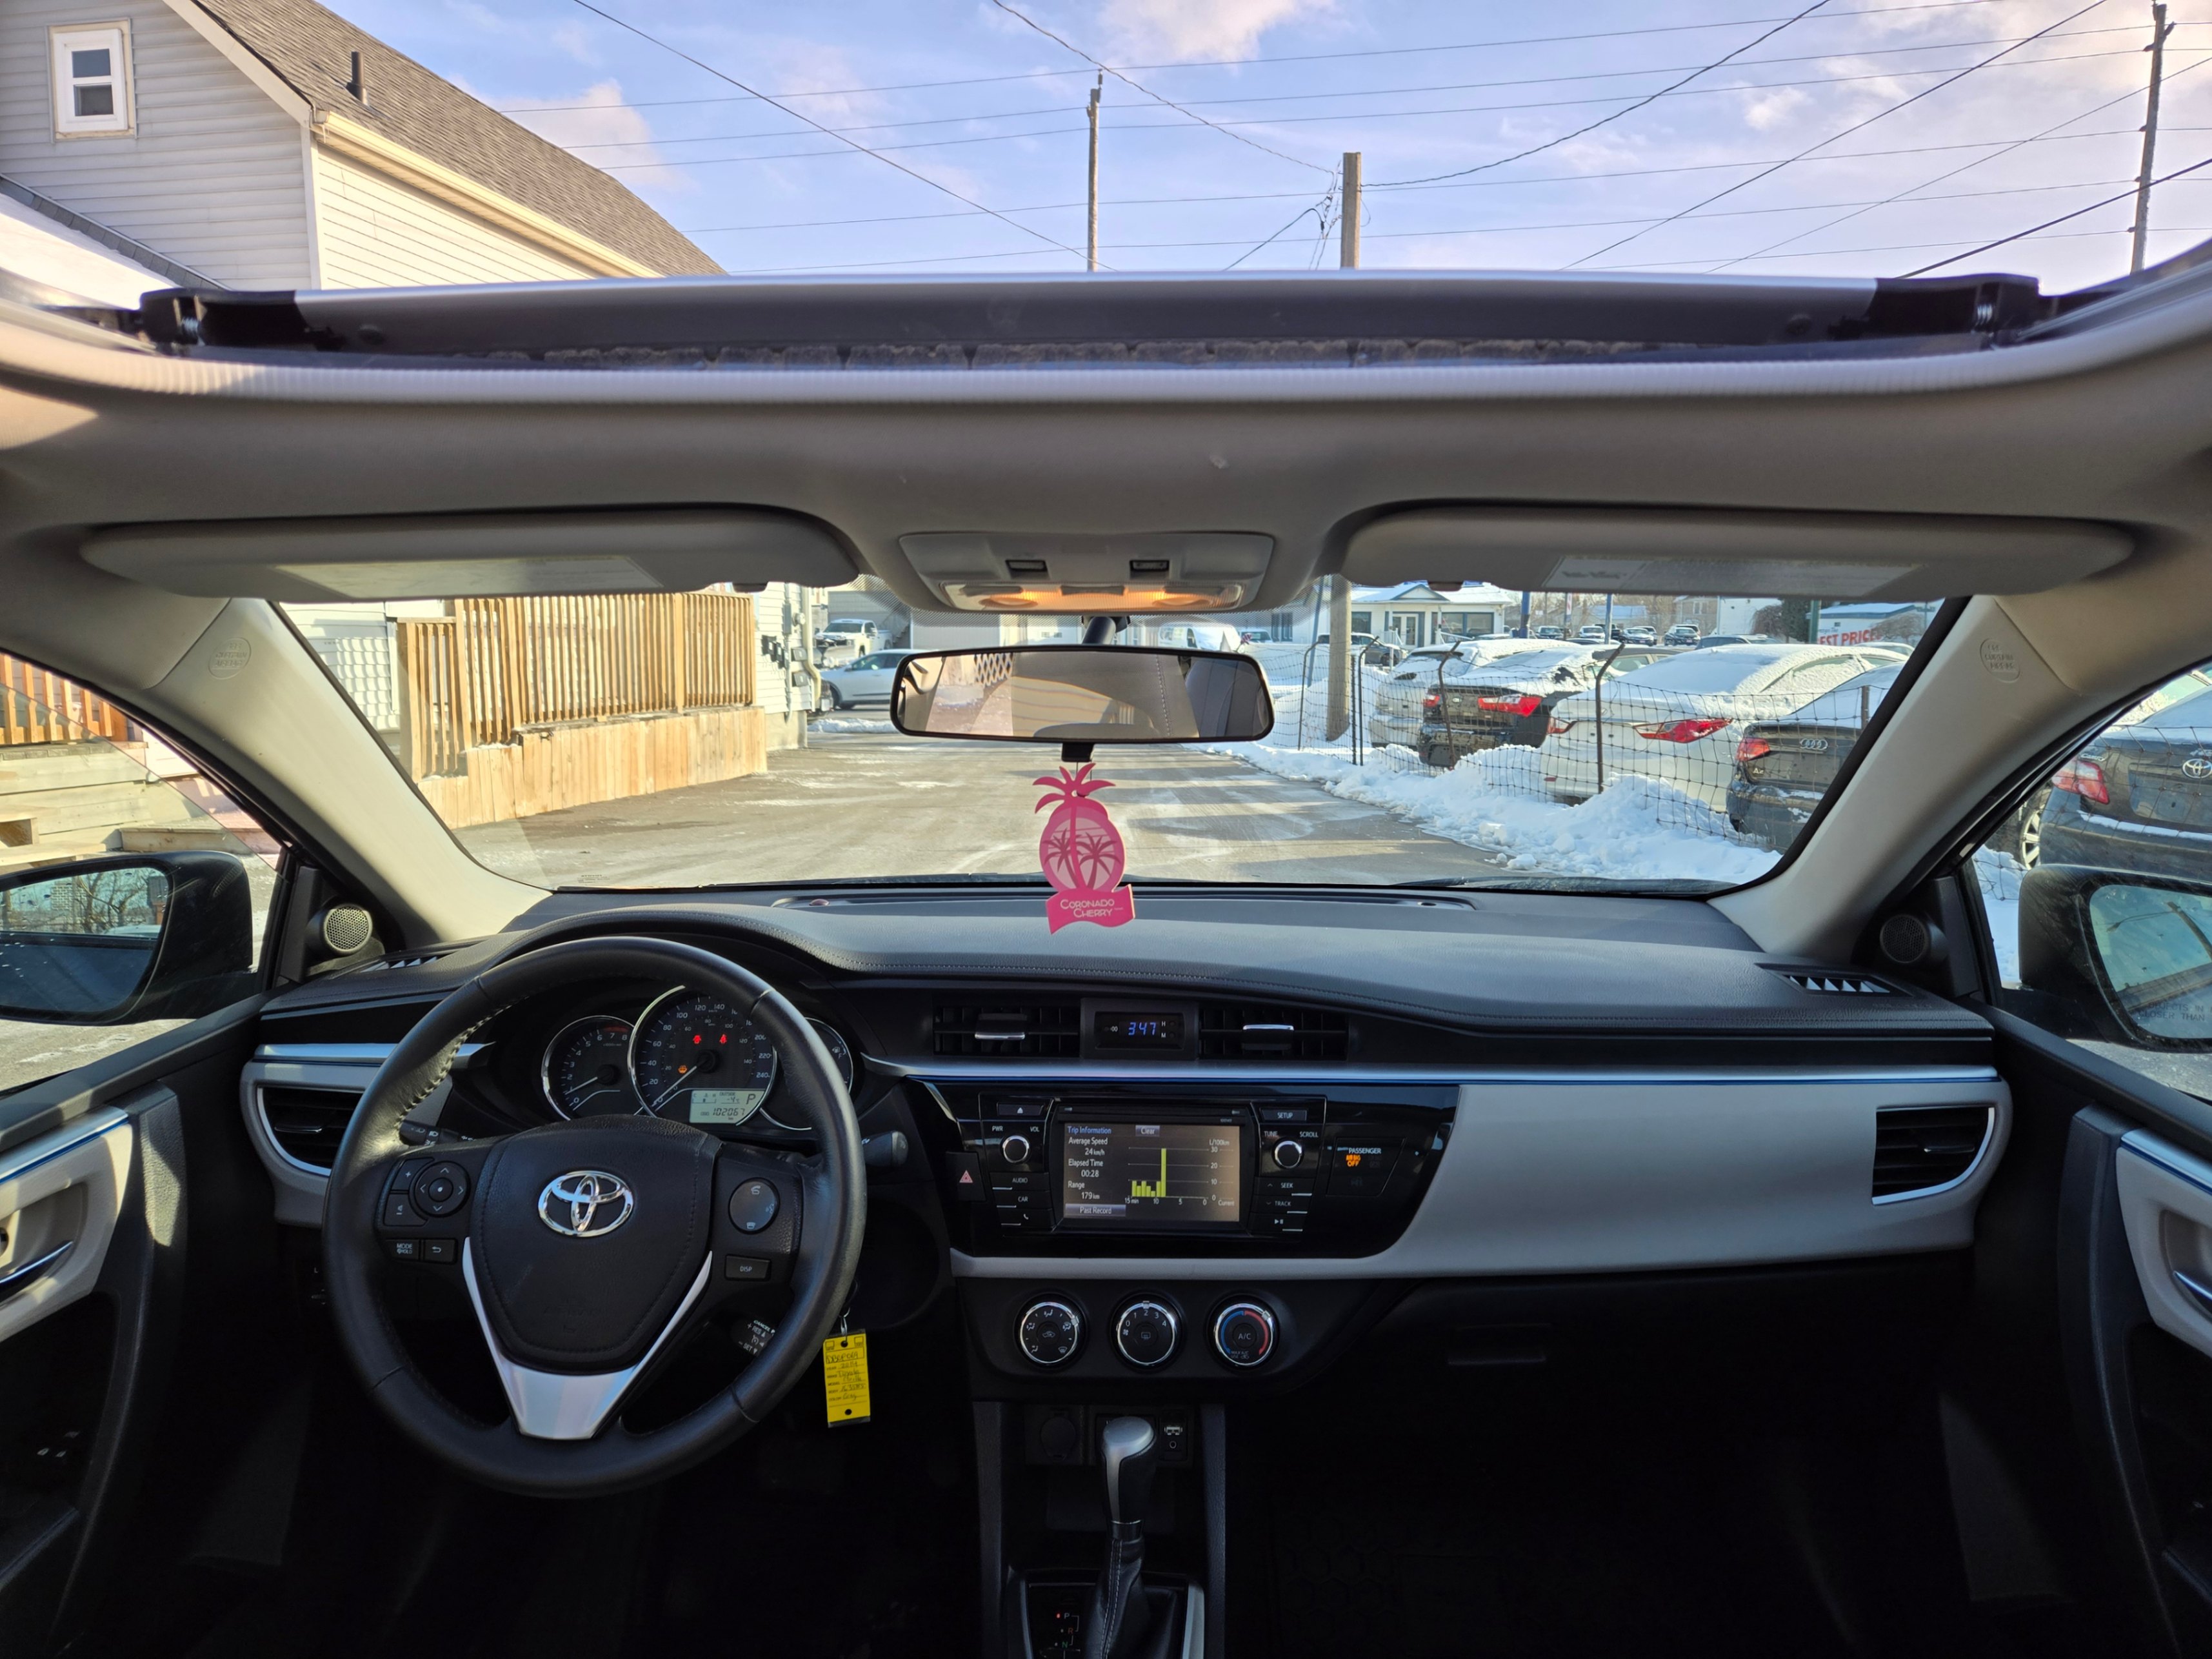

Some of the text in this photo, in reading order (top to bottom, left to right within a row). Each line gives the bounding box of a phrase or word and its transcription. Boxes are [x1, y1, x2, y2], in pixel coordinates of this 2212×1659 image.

[1060, 898, 1115, 910] CORONADO
[1073, 908, 1113, 918] CHERRY
[2147, 1001, 2189, 1012] OBJECTS
[2138, 1010, 2175, 1020] CLOSER
[2182, 1012, 2205, 1021] THAN
[746, 1093, 756, 1105] P
[713, 1108, 745, 1116] 102067
[1068, 1126, 1079, 1134] Trip
[1068, 1137, 1090, 1145] Average
[1068, 1159, 1089, 1167] Elapsed
[1068, 1181, 1085, 1190] Range
[742, 1343, 753, 1352] SET
